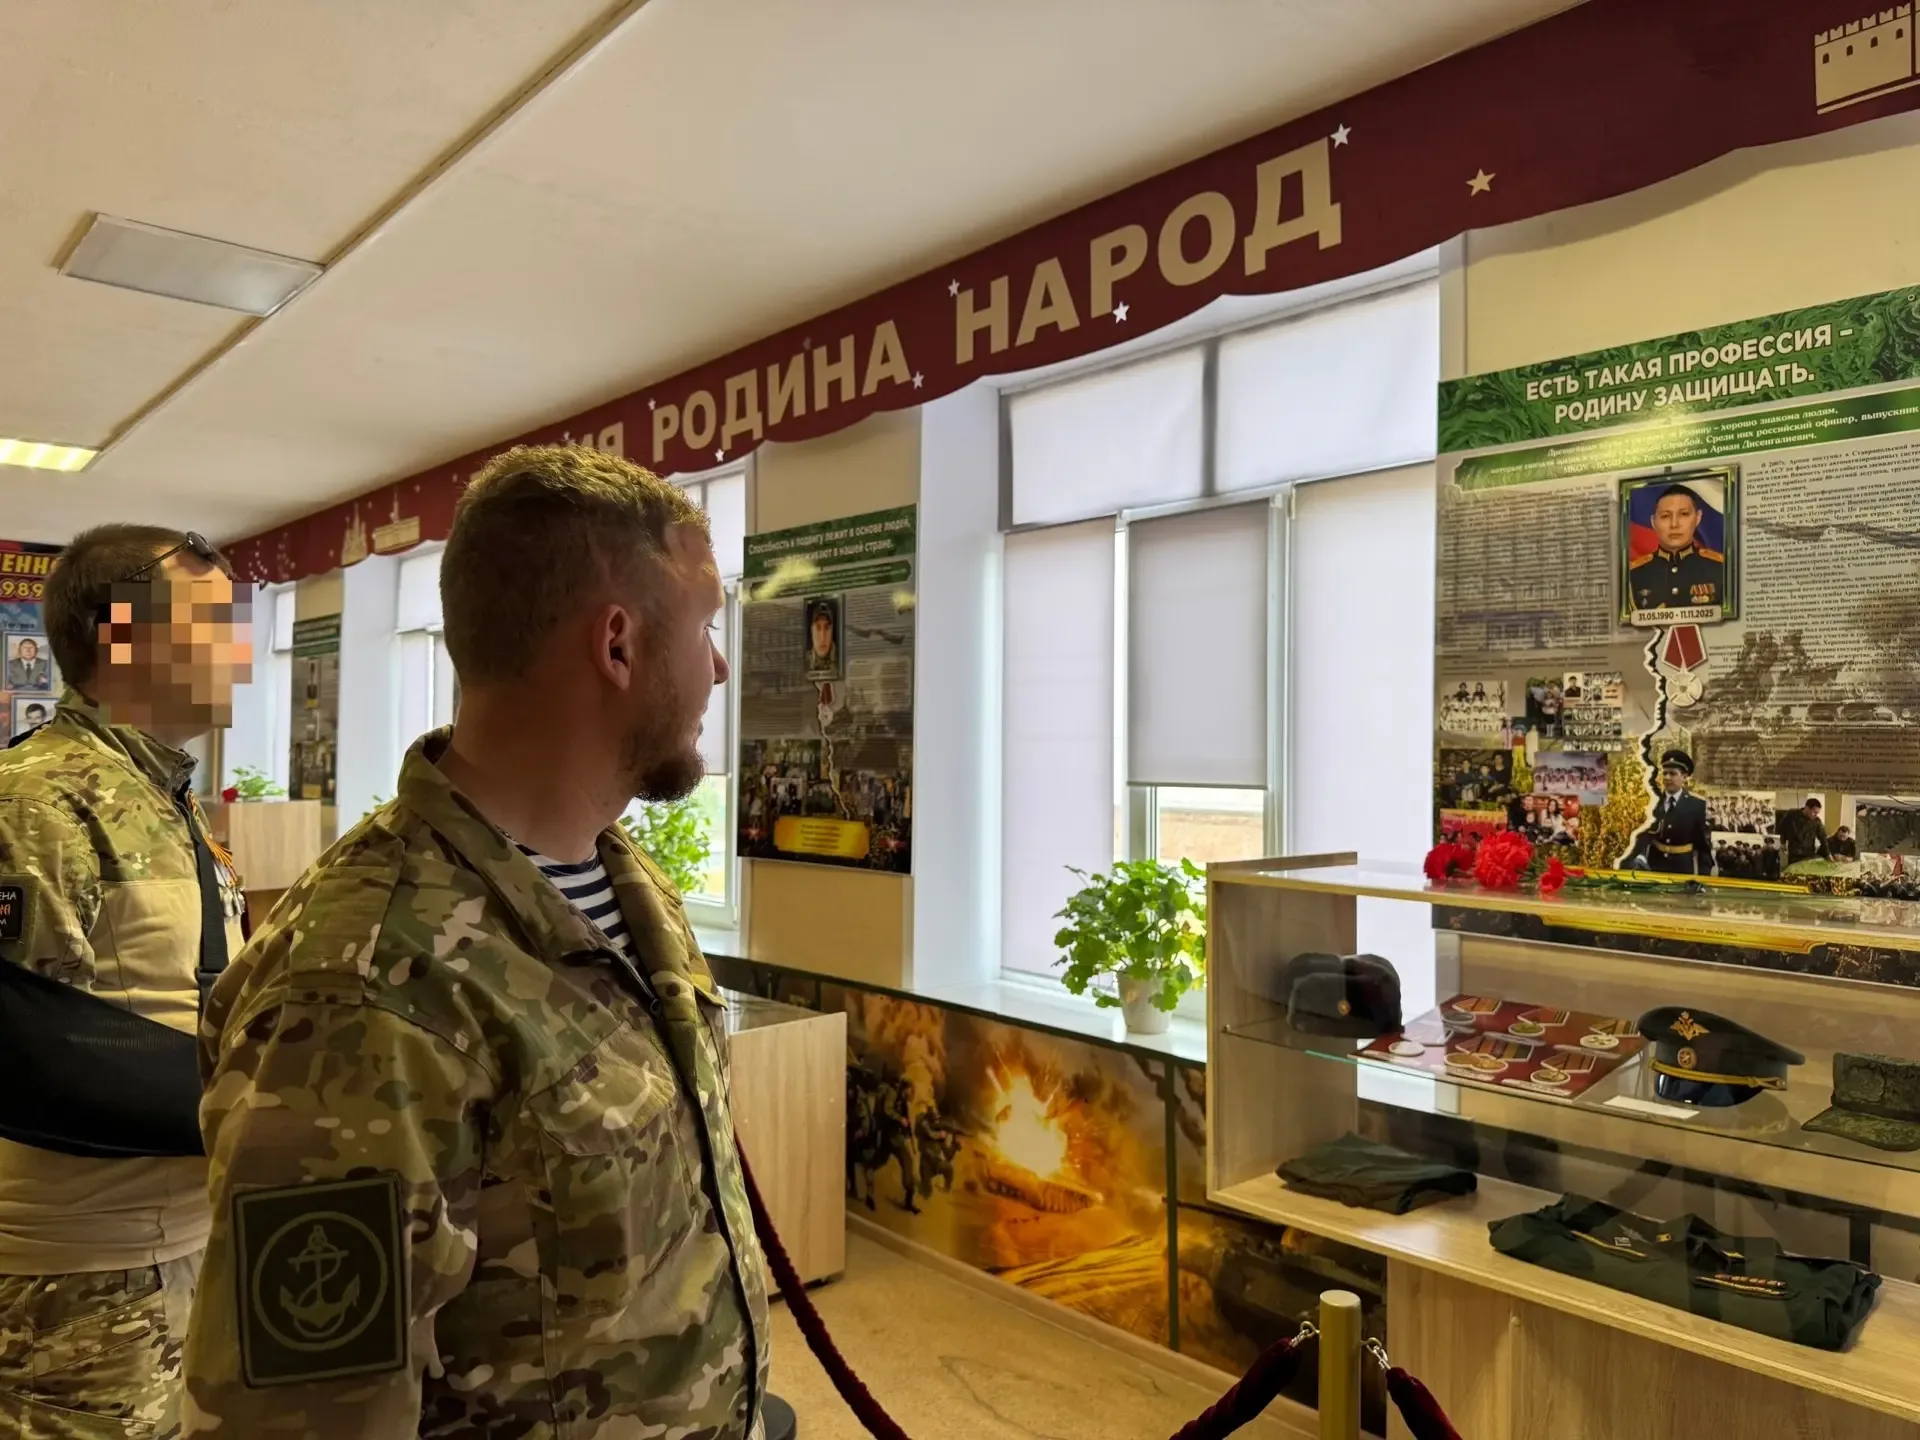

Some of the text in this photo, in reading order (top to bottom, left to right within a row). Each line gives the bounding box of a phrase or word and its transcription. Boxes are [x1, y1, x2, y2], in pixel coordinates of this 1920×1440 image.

[653, 319, 912, 462] РОДИНА
[955, 136, 1344, 364] НАРОД
[1526, 375, 1582, 401] ЕСТЬ
[1584, 357, 1661, 390] ТАКАЯ
[1669, 323, 1832, 374] ПРОФЕССИЯ
[1554, 362, 1815, 425] РОДИНУ ЗАЩИЩАТЬ.
[1706, 432, 1735, 445] Среди
[1736, 430, 1754, 440] них
[1756, 419, 1812, 438] российский
[1815, 413, 1858, 429] офицер,
[1861, 406, 1919, 422] выпускник
[1721, 419, 1757, 432] хорошо
[1760, 412, 1800, 425] знакома
[1802, 407, 1839, 420] людям,
[1710, 441, 1740, 454] Арман
